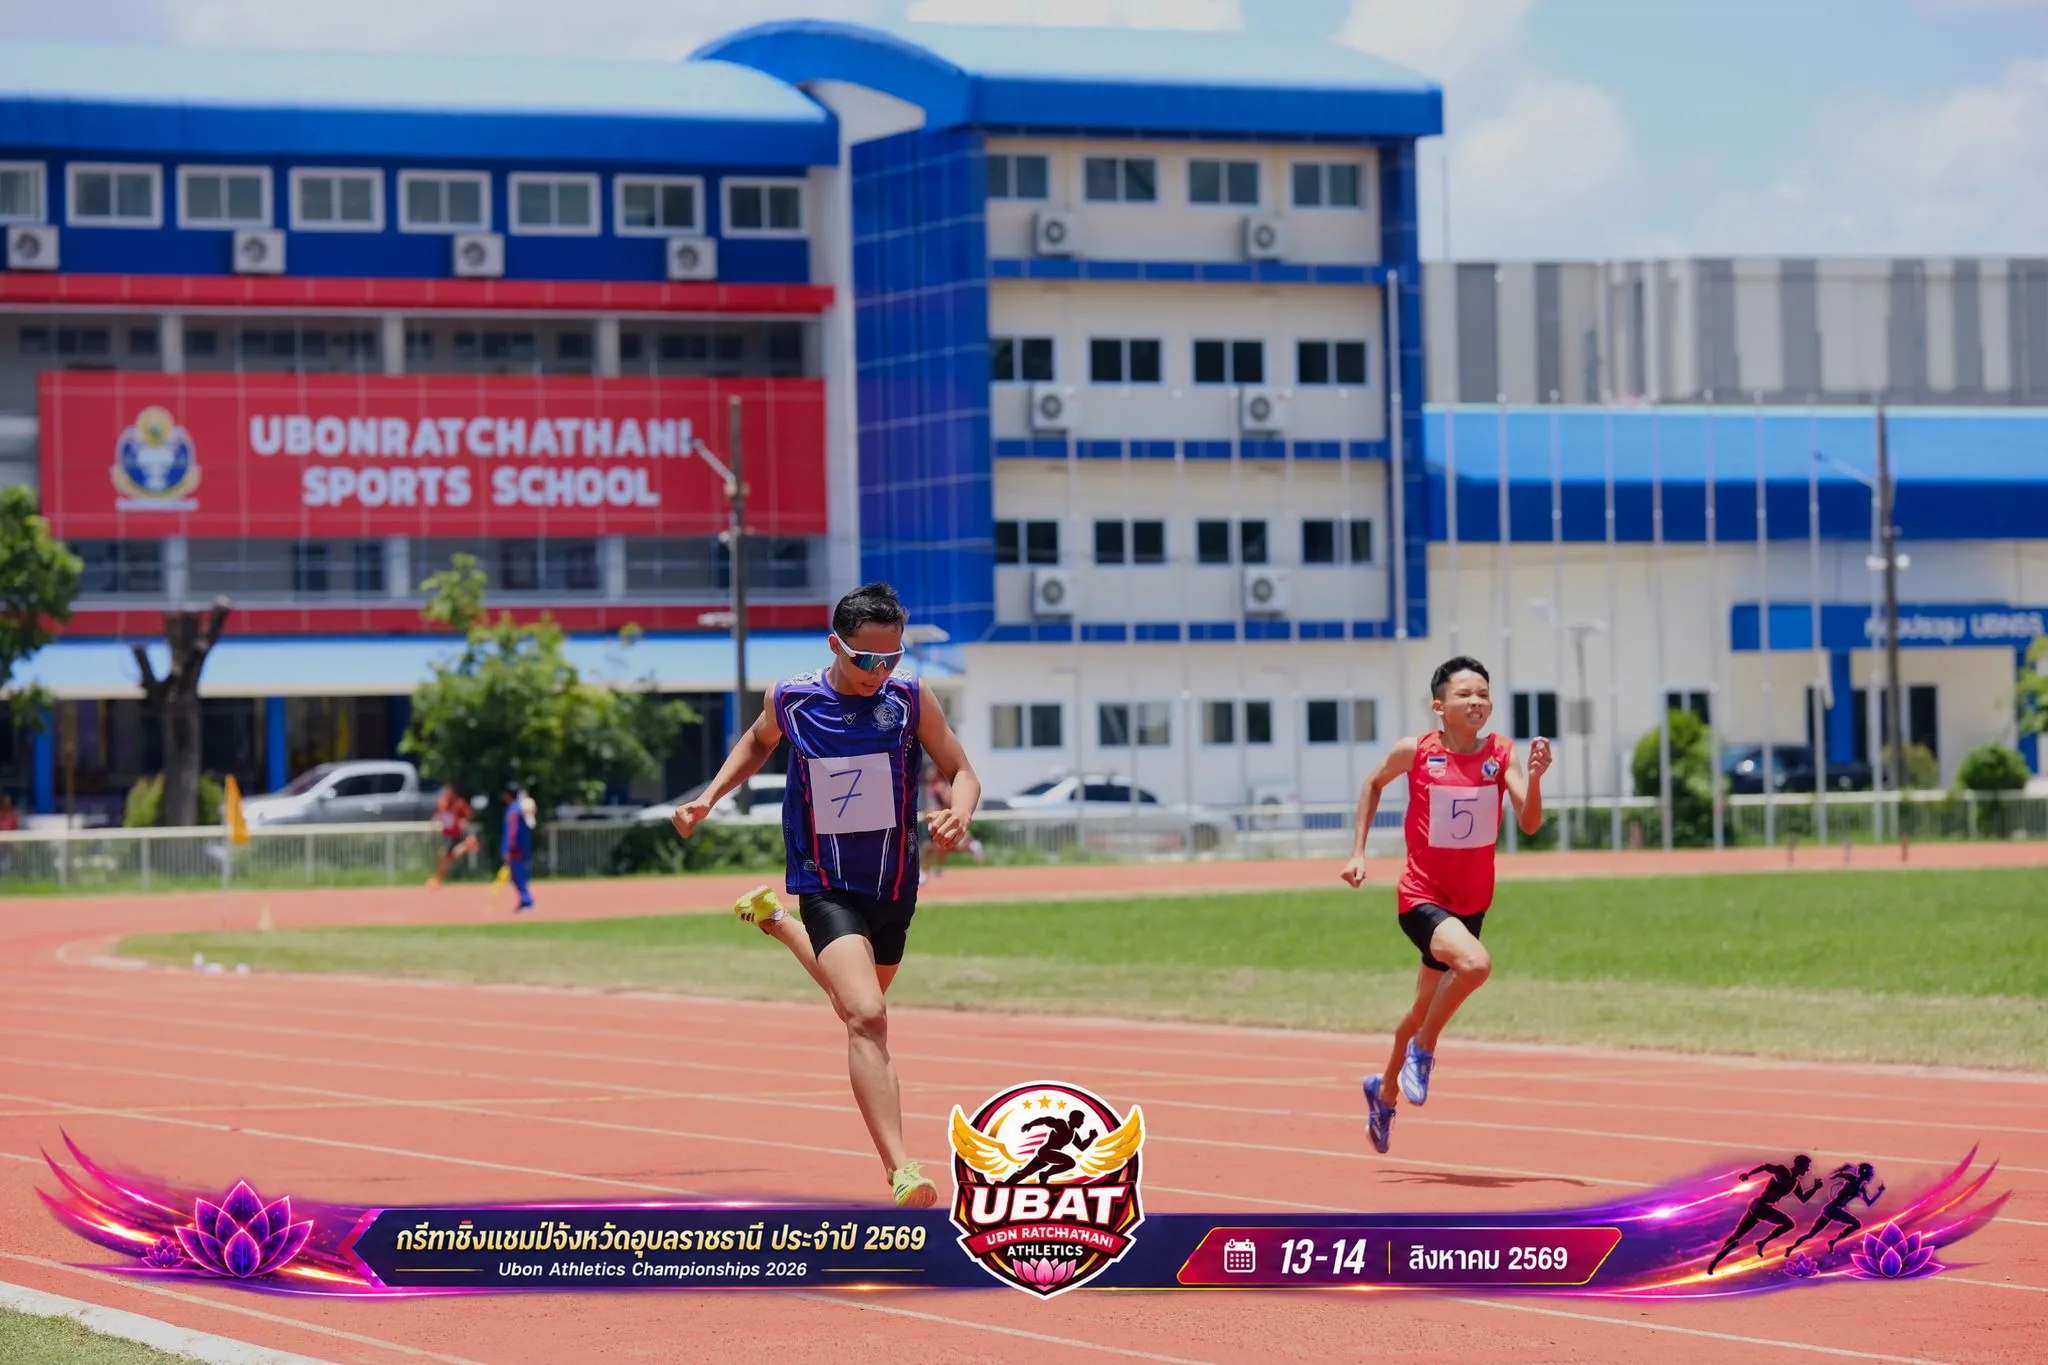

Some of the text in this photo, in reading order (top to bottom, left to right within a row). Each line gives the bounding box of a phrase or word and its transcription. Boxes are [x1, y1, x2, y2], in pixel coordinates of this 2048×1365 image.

[250, 415, 692, 457] UBONRATCHATHANI
[302, 466, 661, 507] SPORTS SCHOOL
[829, 768, 863, 818] 7
[1451, 798, 1479, 840] 5
